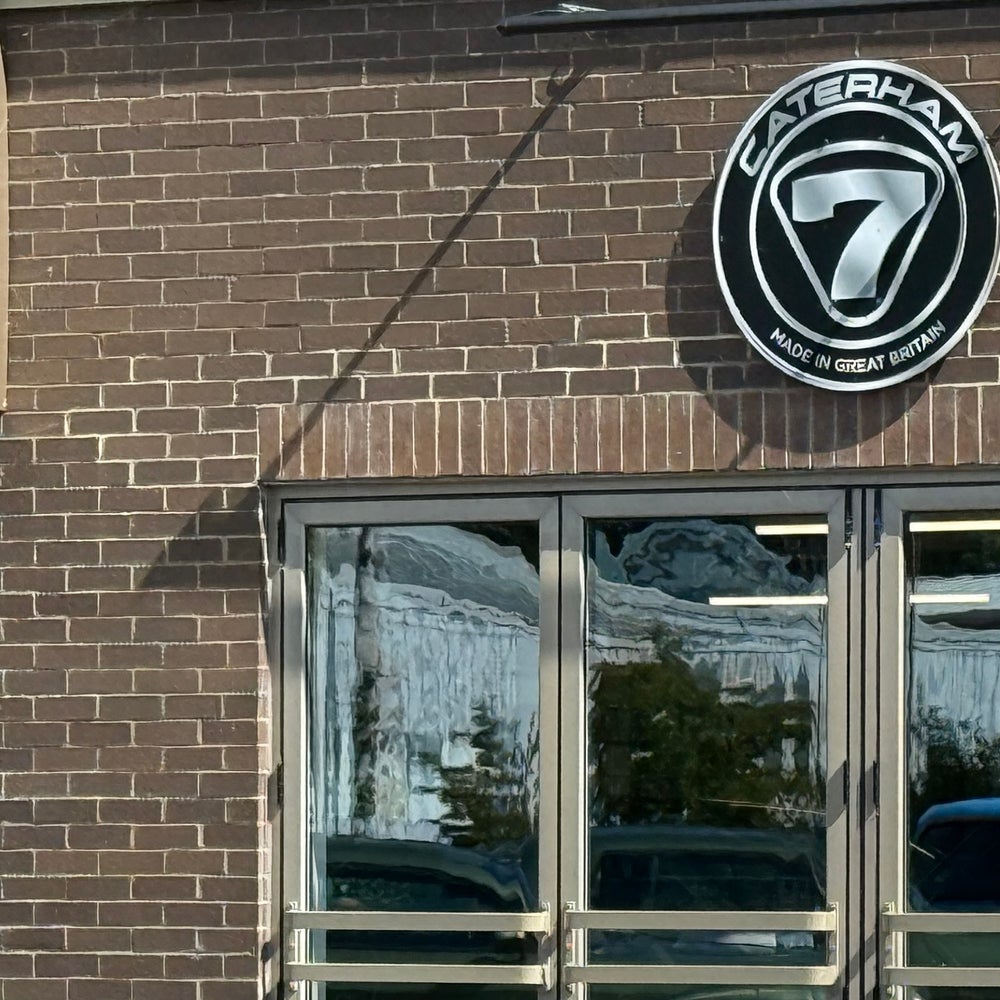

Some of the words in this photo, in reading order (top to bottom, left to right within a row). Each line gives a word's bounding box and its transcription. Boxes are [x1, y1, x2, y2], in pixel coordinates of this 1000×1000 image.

[739, 73, 978, 177] CATERHAM
[792, 168, 926, 300] 7
[769, 327, 812, 364] MADE
[815, 351, 832, 371] IN
[834, 355, 885, 373] GREAT
[888, 319, 946, 367] BRITAIN
